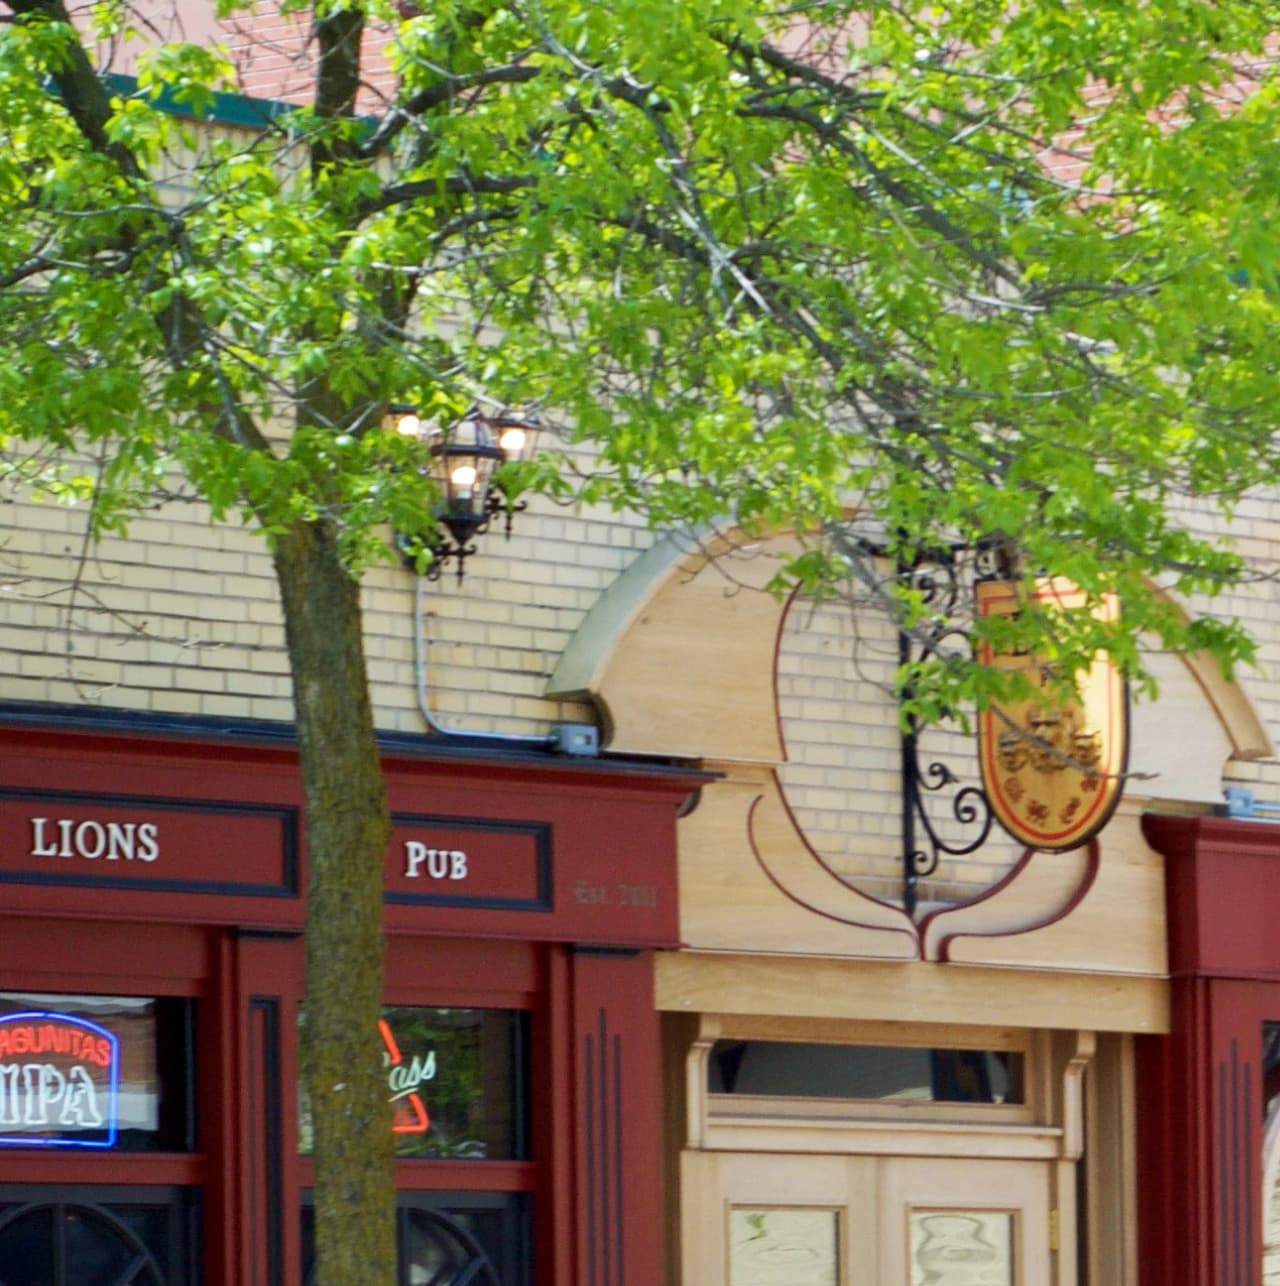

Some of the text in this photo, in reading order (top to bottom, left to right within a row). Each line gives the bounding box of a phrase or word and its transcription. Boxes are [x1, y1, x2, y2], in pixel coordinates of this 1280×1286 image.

[30, 817, 160, 862] LIONS
[0, 1023, 112, 1068] AGUNITAS
[383, 1050, 437, 1092] ass
